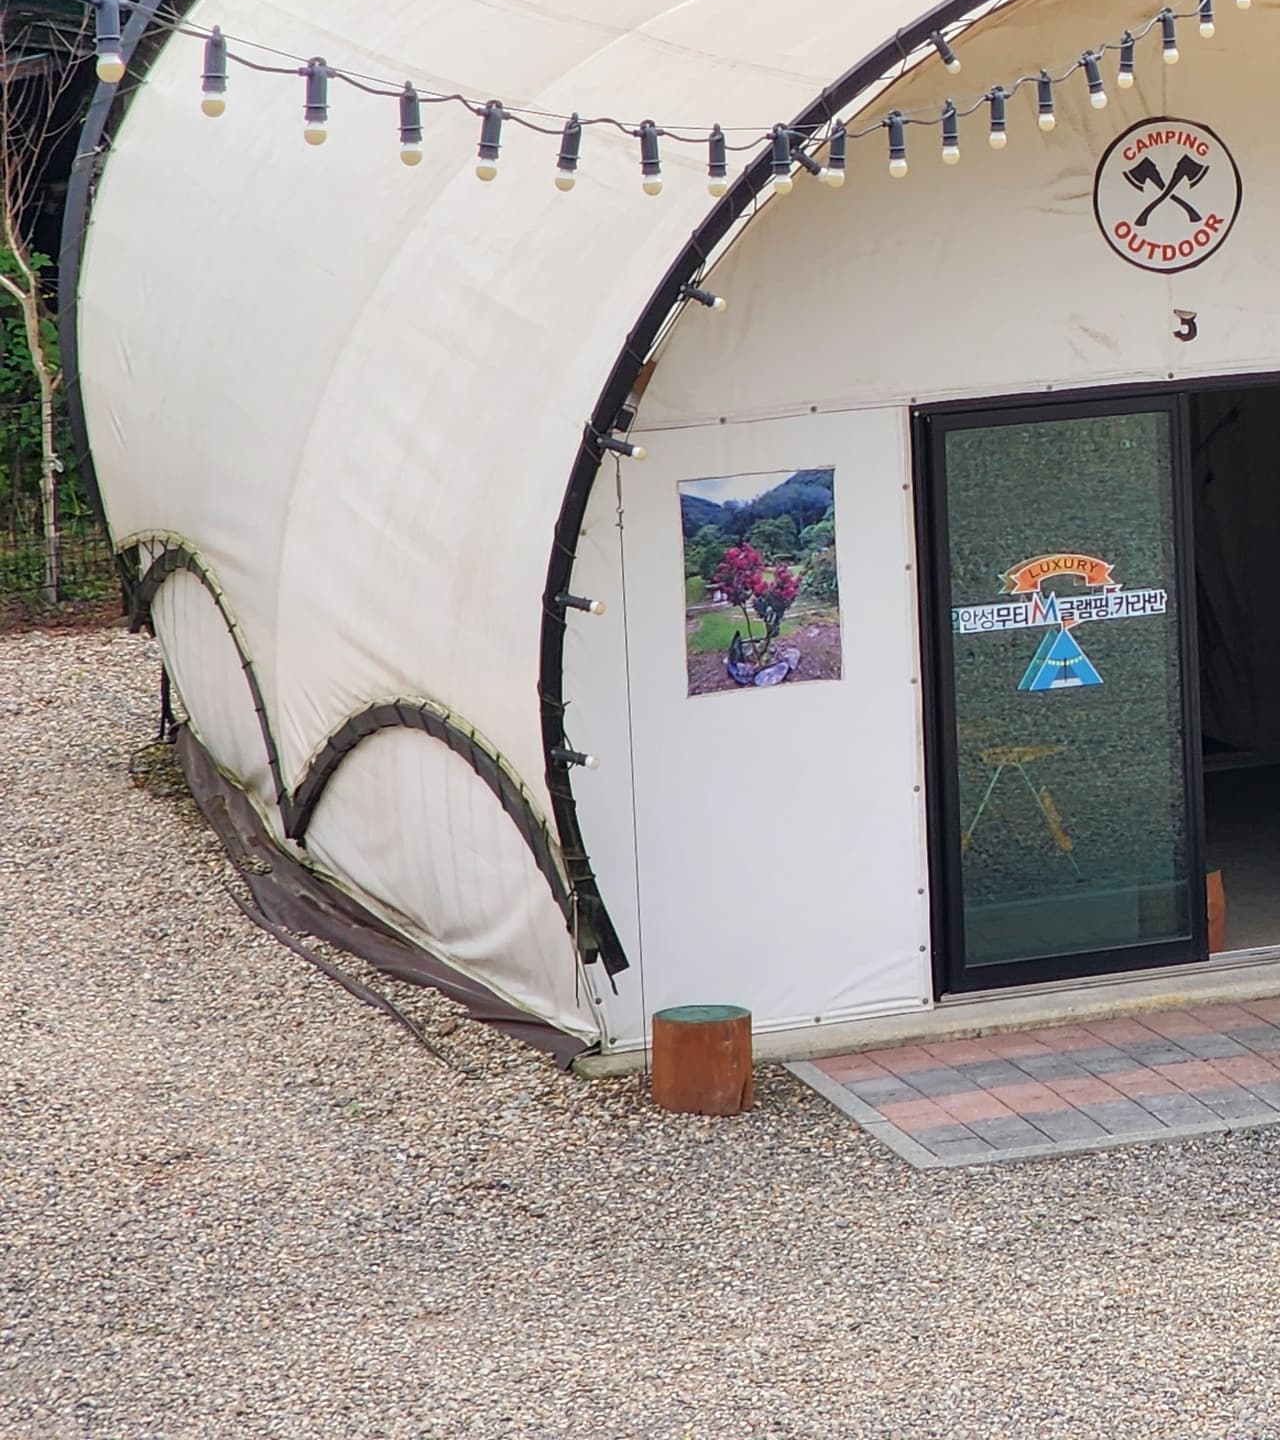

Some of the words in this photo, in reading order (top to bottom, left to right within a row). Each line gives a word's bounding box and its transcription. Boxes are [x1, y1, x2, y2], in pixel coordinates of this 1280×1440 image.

[1123, 130, 1209, 161] CAMPING
[1114, 213, 1224, 261] OUTDOOR
[1173, 309, 1197, 341] 3
[1028, 559, 1097, 579] LUXURY
